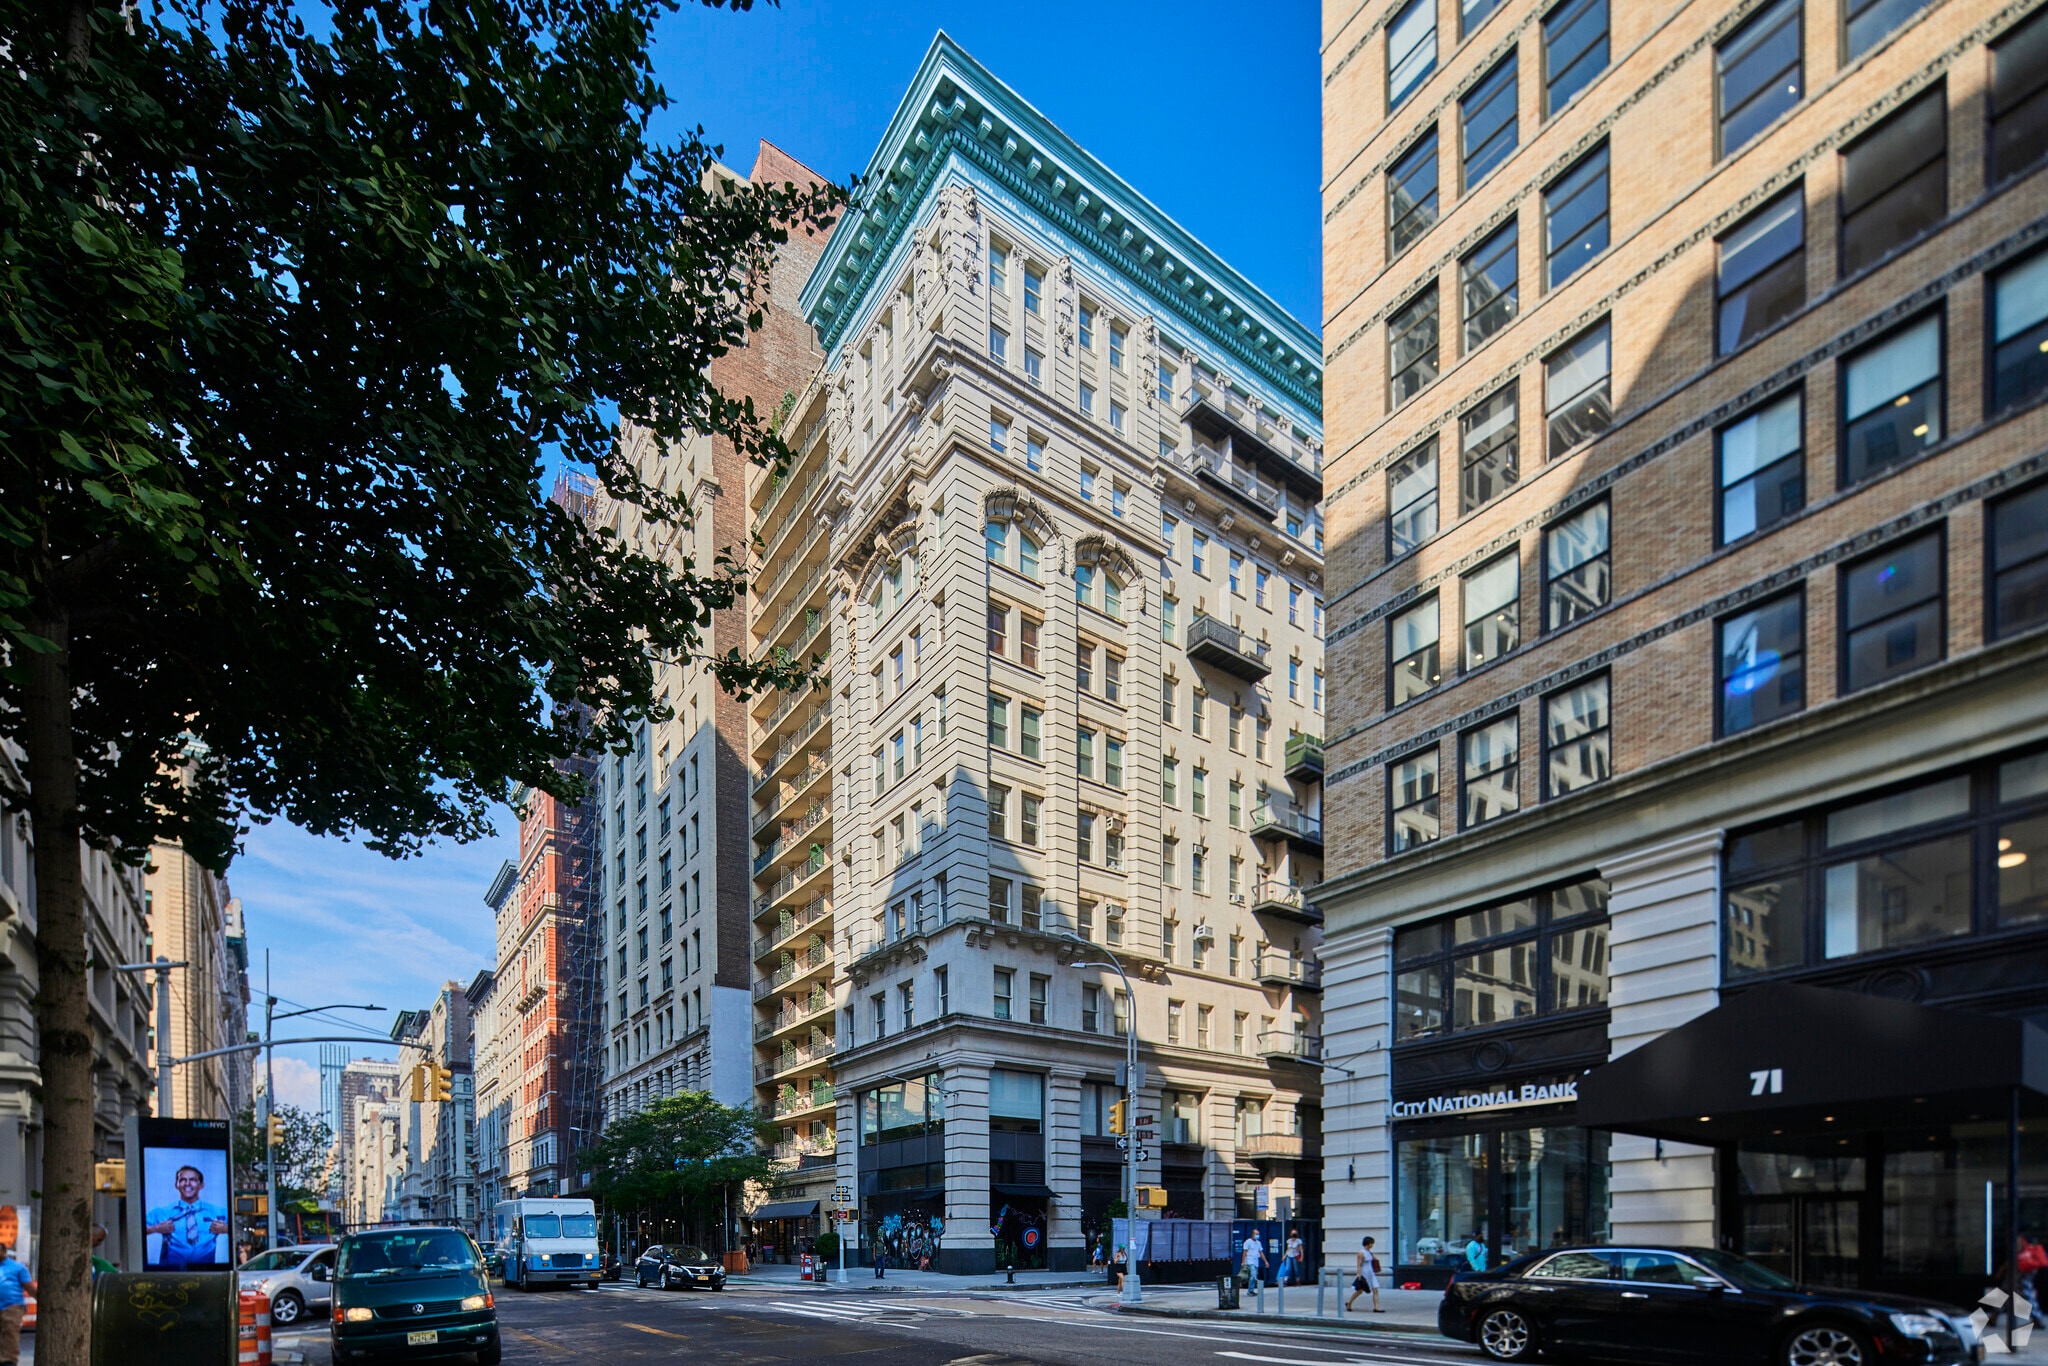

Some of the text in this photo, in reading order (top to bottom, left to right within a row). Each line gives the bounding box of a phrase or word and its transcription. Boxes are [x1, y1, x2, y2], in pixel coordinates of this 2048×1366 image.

[1750, 1068, 1782, 1096] 71
[1392, 1081, 1578, 1117] CITY NATIONAL BANK
